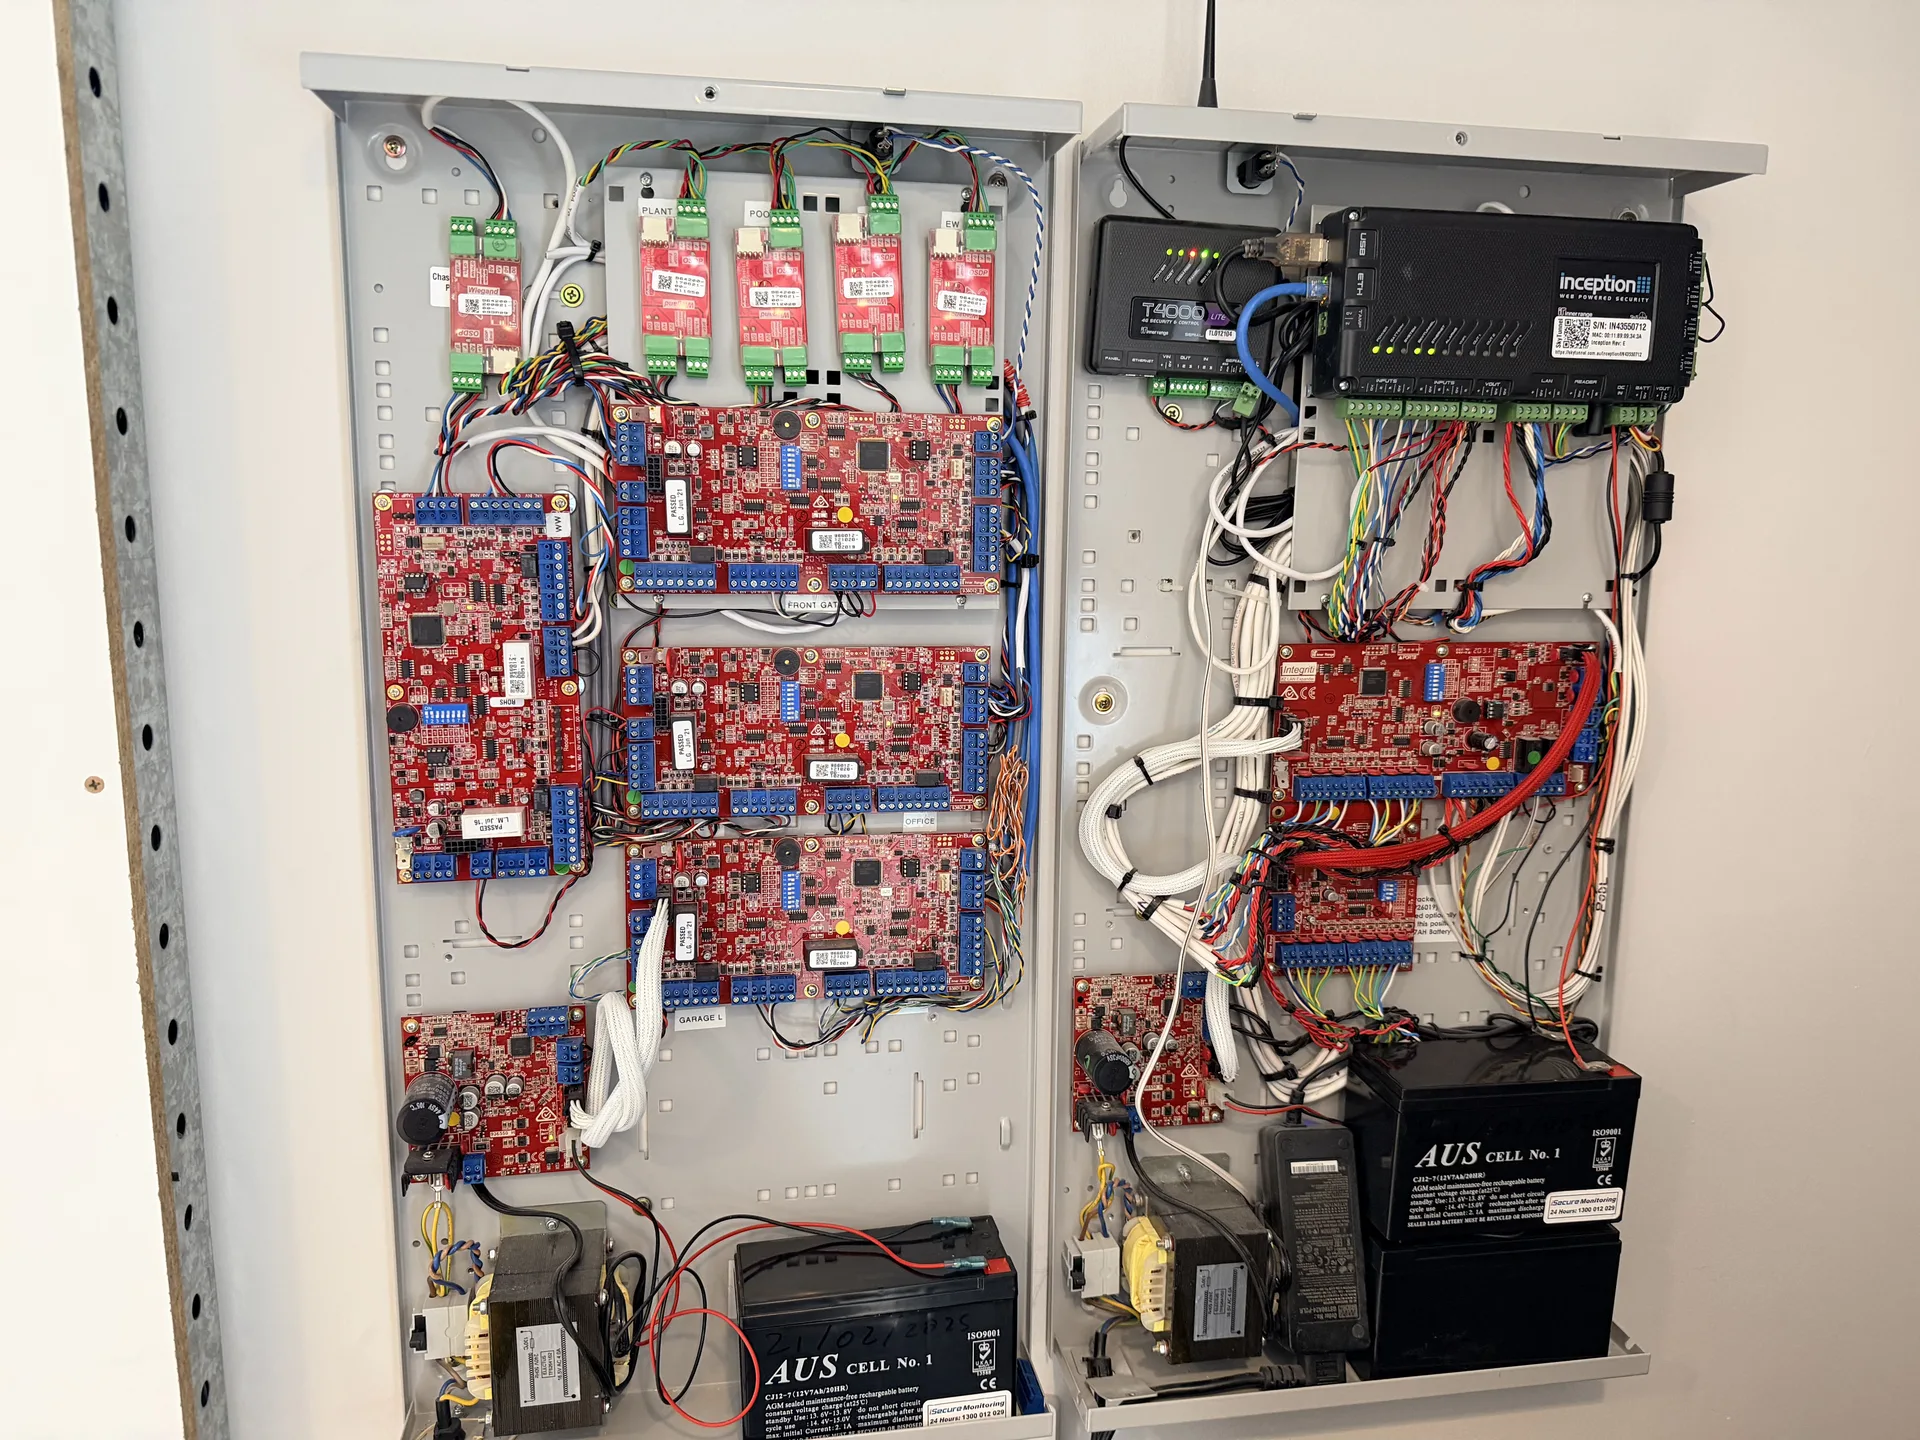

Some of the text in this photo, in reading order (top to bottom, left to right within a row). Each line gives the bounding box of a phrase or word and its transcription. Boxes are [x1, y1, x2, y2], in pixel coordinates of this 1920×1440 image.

[642, 206, 673, 216] PLANT
[750, 210, 770, 218] POO
[432, 272, 449, 281] Chas
[1560, 272, 1636, 295] inception
[1142, 302, 1206, 320] T4000
[1609, 322, 1647, 331] IN43550712
[1283, 666, 1315, 675] Integriti
[679, 1015, 714, 1024] GARAGE
[1592, 1128, 1621, 1136] ISO9001
[1414, 1142, 1560, 1168] AUS CELL No. 1
[1447, 1180, 1492, 1190] maintenance-free
[1493, 1177, 1526, 1186] rechargeable
[967, 1329, 1000, 1340] ISO9001
[765, 1354, 932, 1385] AUS CELL No. 1
[806, 1394, 858, 1405] maintenance-free
[860, 1389, 897, 1398] rechargeable
[930, 1401, 1005, 1414] iSecure Monitoring
[858, 1411, 898, 1420] rechargeable
[857, 1415, 922, 1428] maximum discharge
